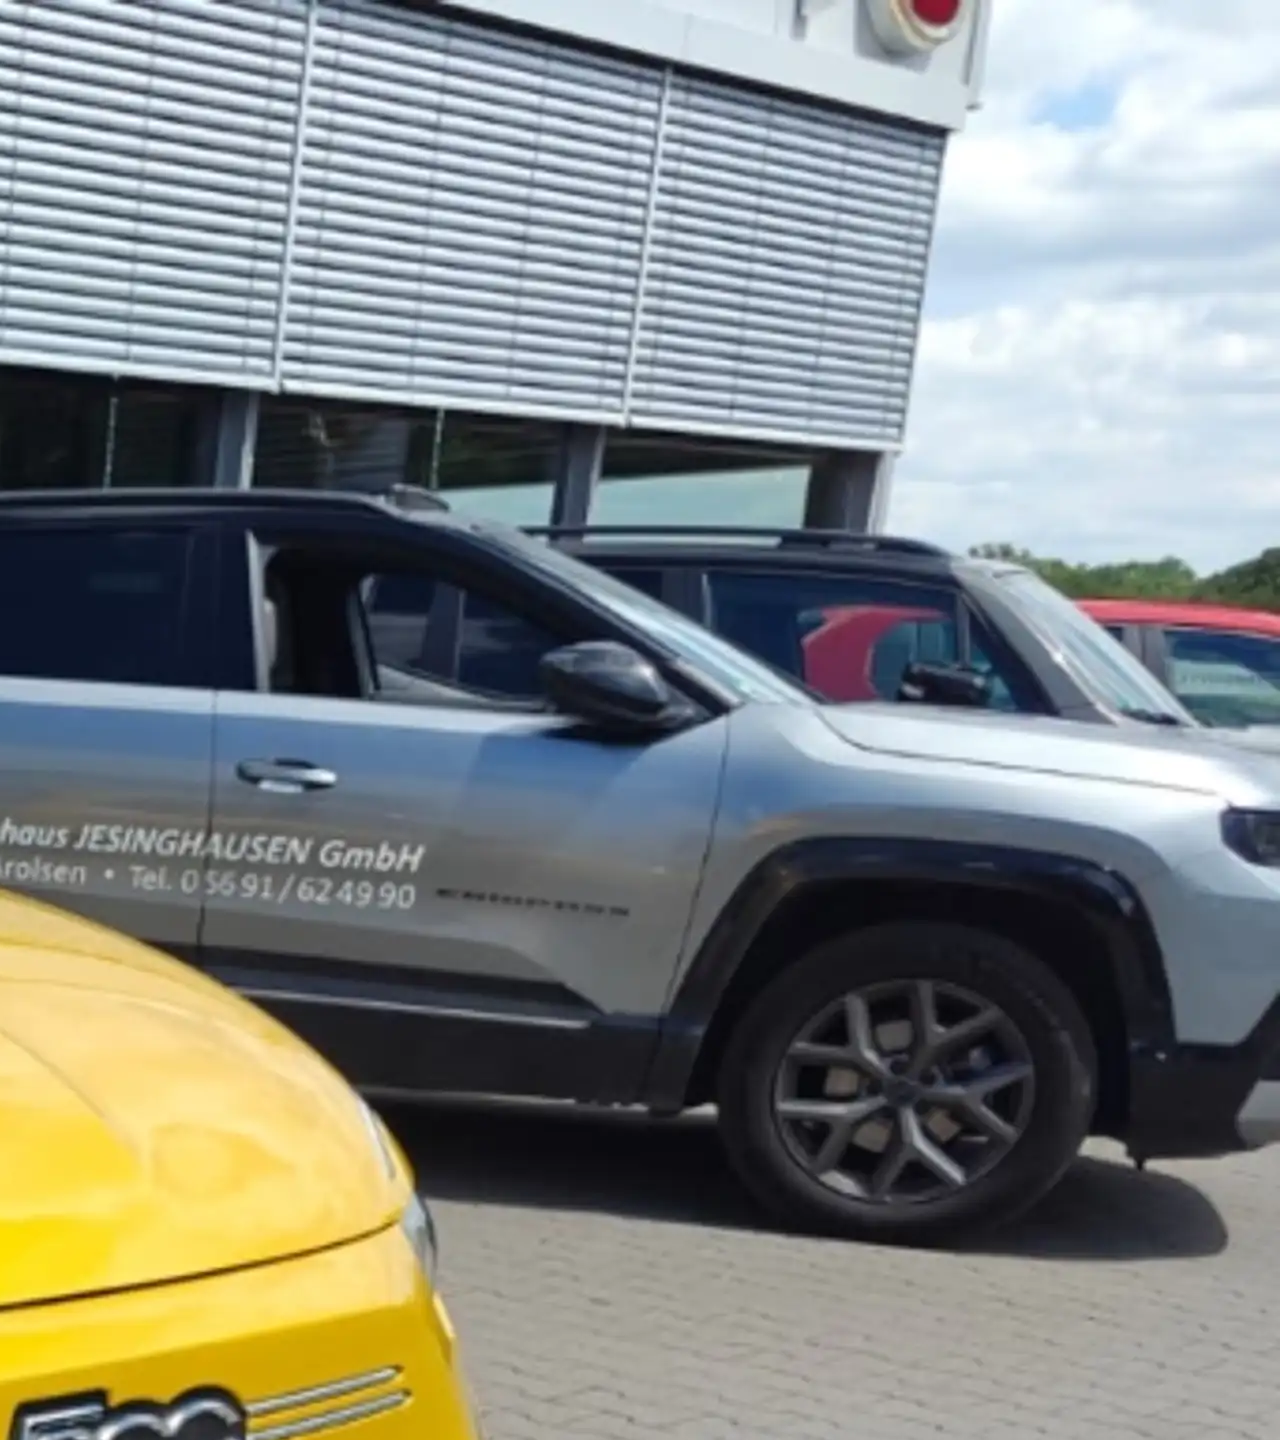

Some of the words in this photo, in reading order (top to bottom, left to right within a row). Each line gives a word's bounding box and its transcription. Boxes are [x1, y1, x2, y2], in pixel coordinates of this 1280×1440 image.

[72, 823, 314, 864] JESINGHAUSEN
[319, 840, 426, 873] GmbH
[129, 864, 172, 891] Tel.
